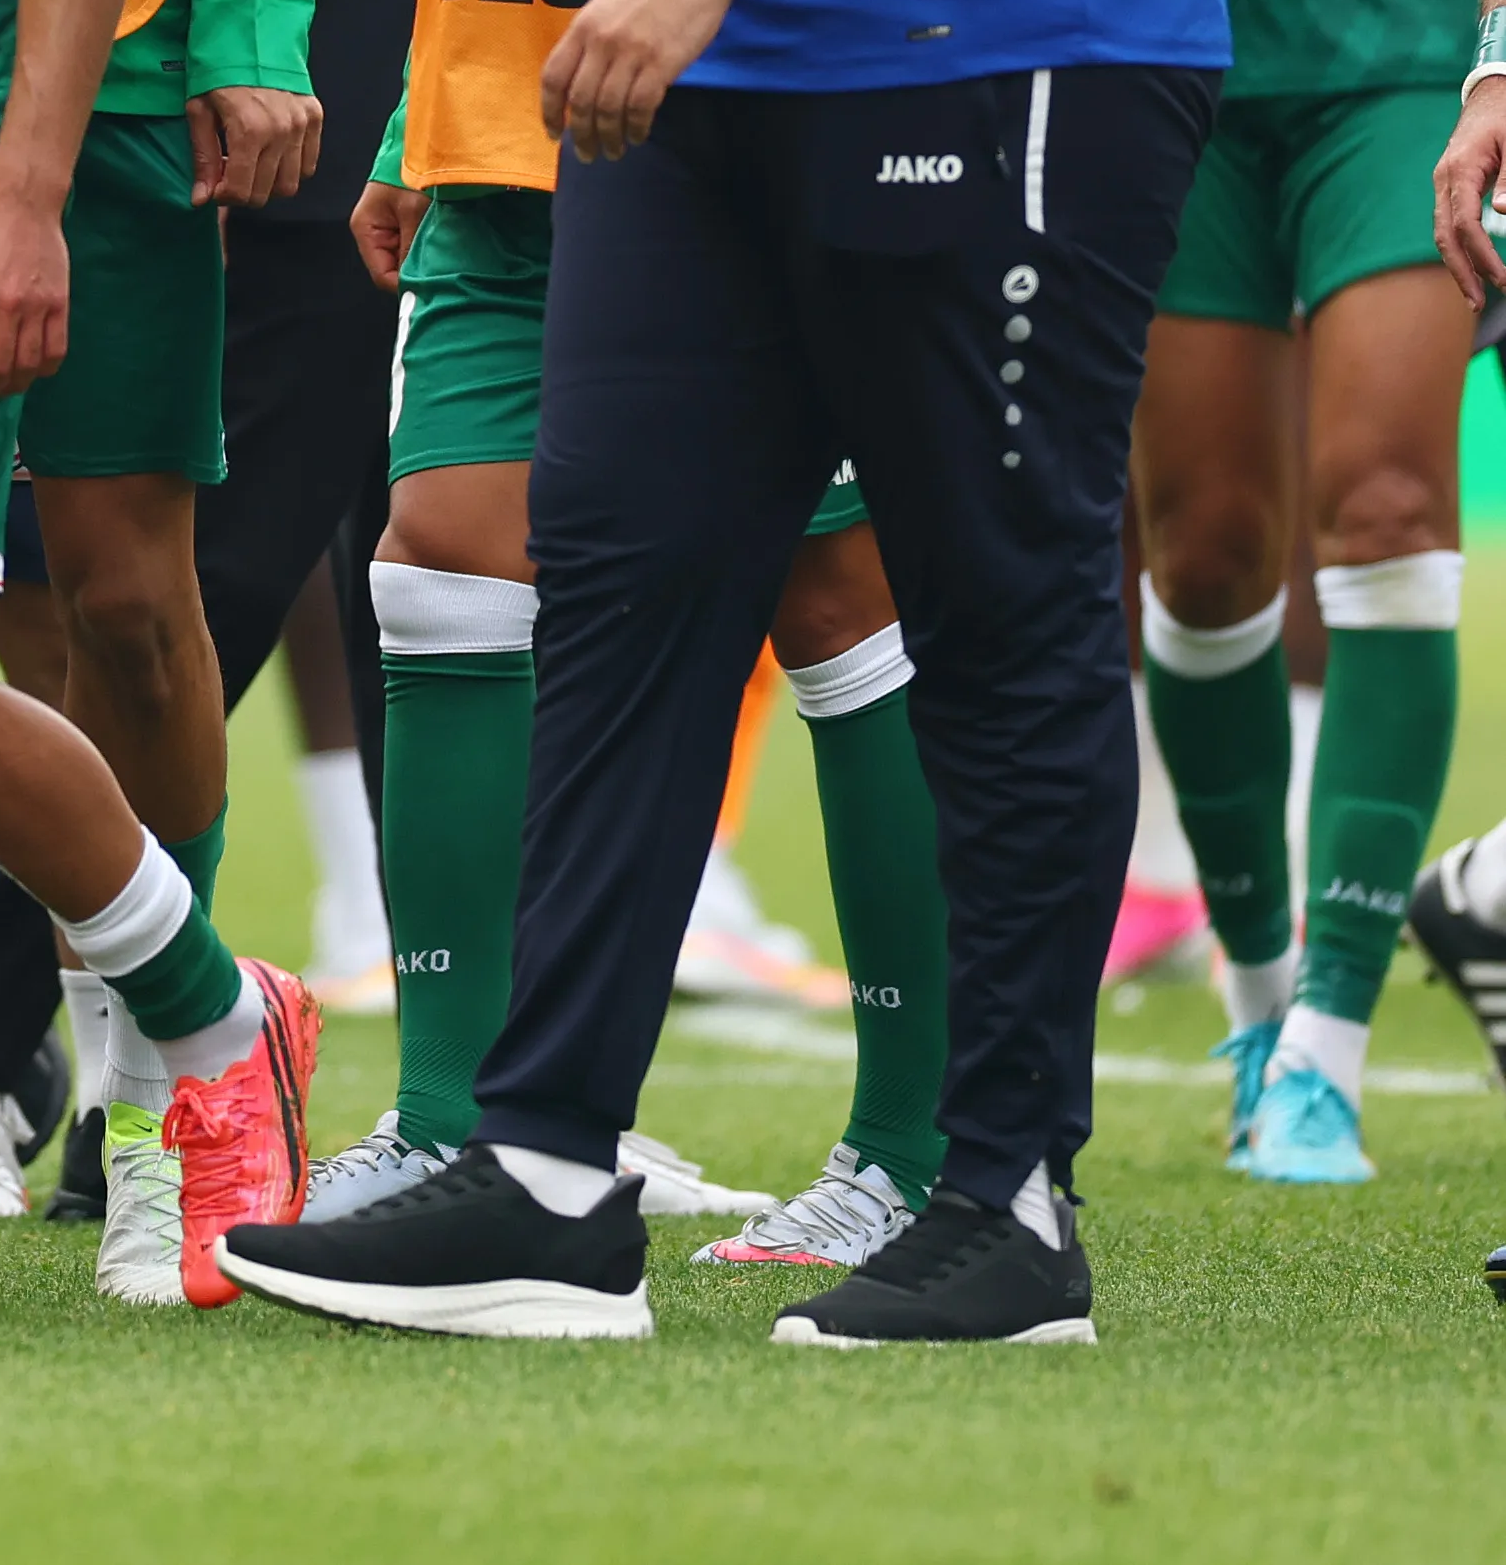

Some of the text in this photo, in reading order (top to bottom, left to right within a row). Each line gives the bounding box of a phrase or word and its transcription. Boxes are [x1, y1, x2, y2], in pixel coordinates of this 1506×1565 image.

[876, 153, 964, 184] JAKO
[394, 948, 451, 976] AKO
[850, 980, 903, 1009] AKO
